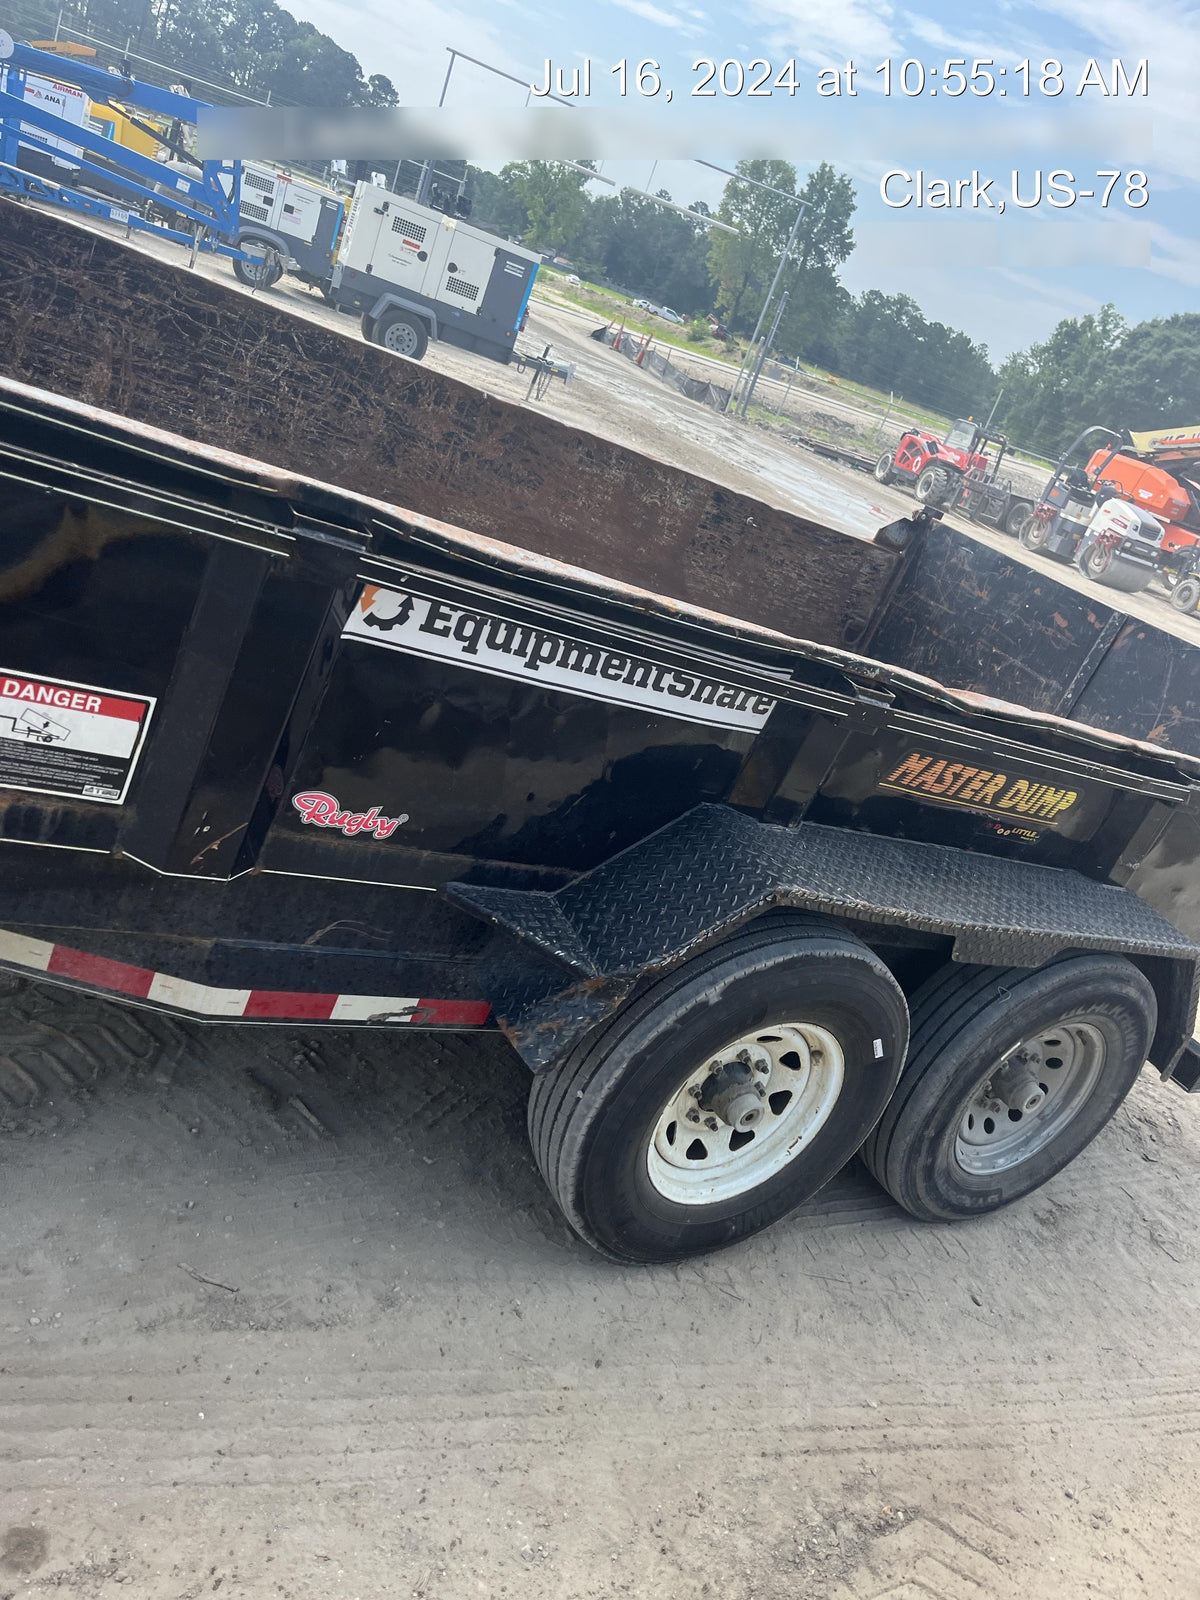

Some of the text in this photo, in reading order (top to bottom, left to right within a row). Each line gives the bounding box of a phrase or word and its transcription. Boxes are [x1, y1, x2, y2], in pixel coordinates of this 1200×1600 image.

[44, 95, 61, 105] ANA
[52, 83, 83, 99] AIRMAN
[2, 679, 102, 712] DANGER
[887, 753, 1078, 819] MASTER DUMP
